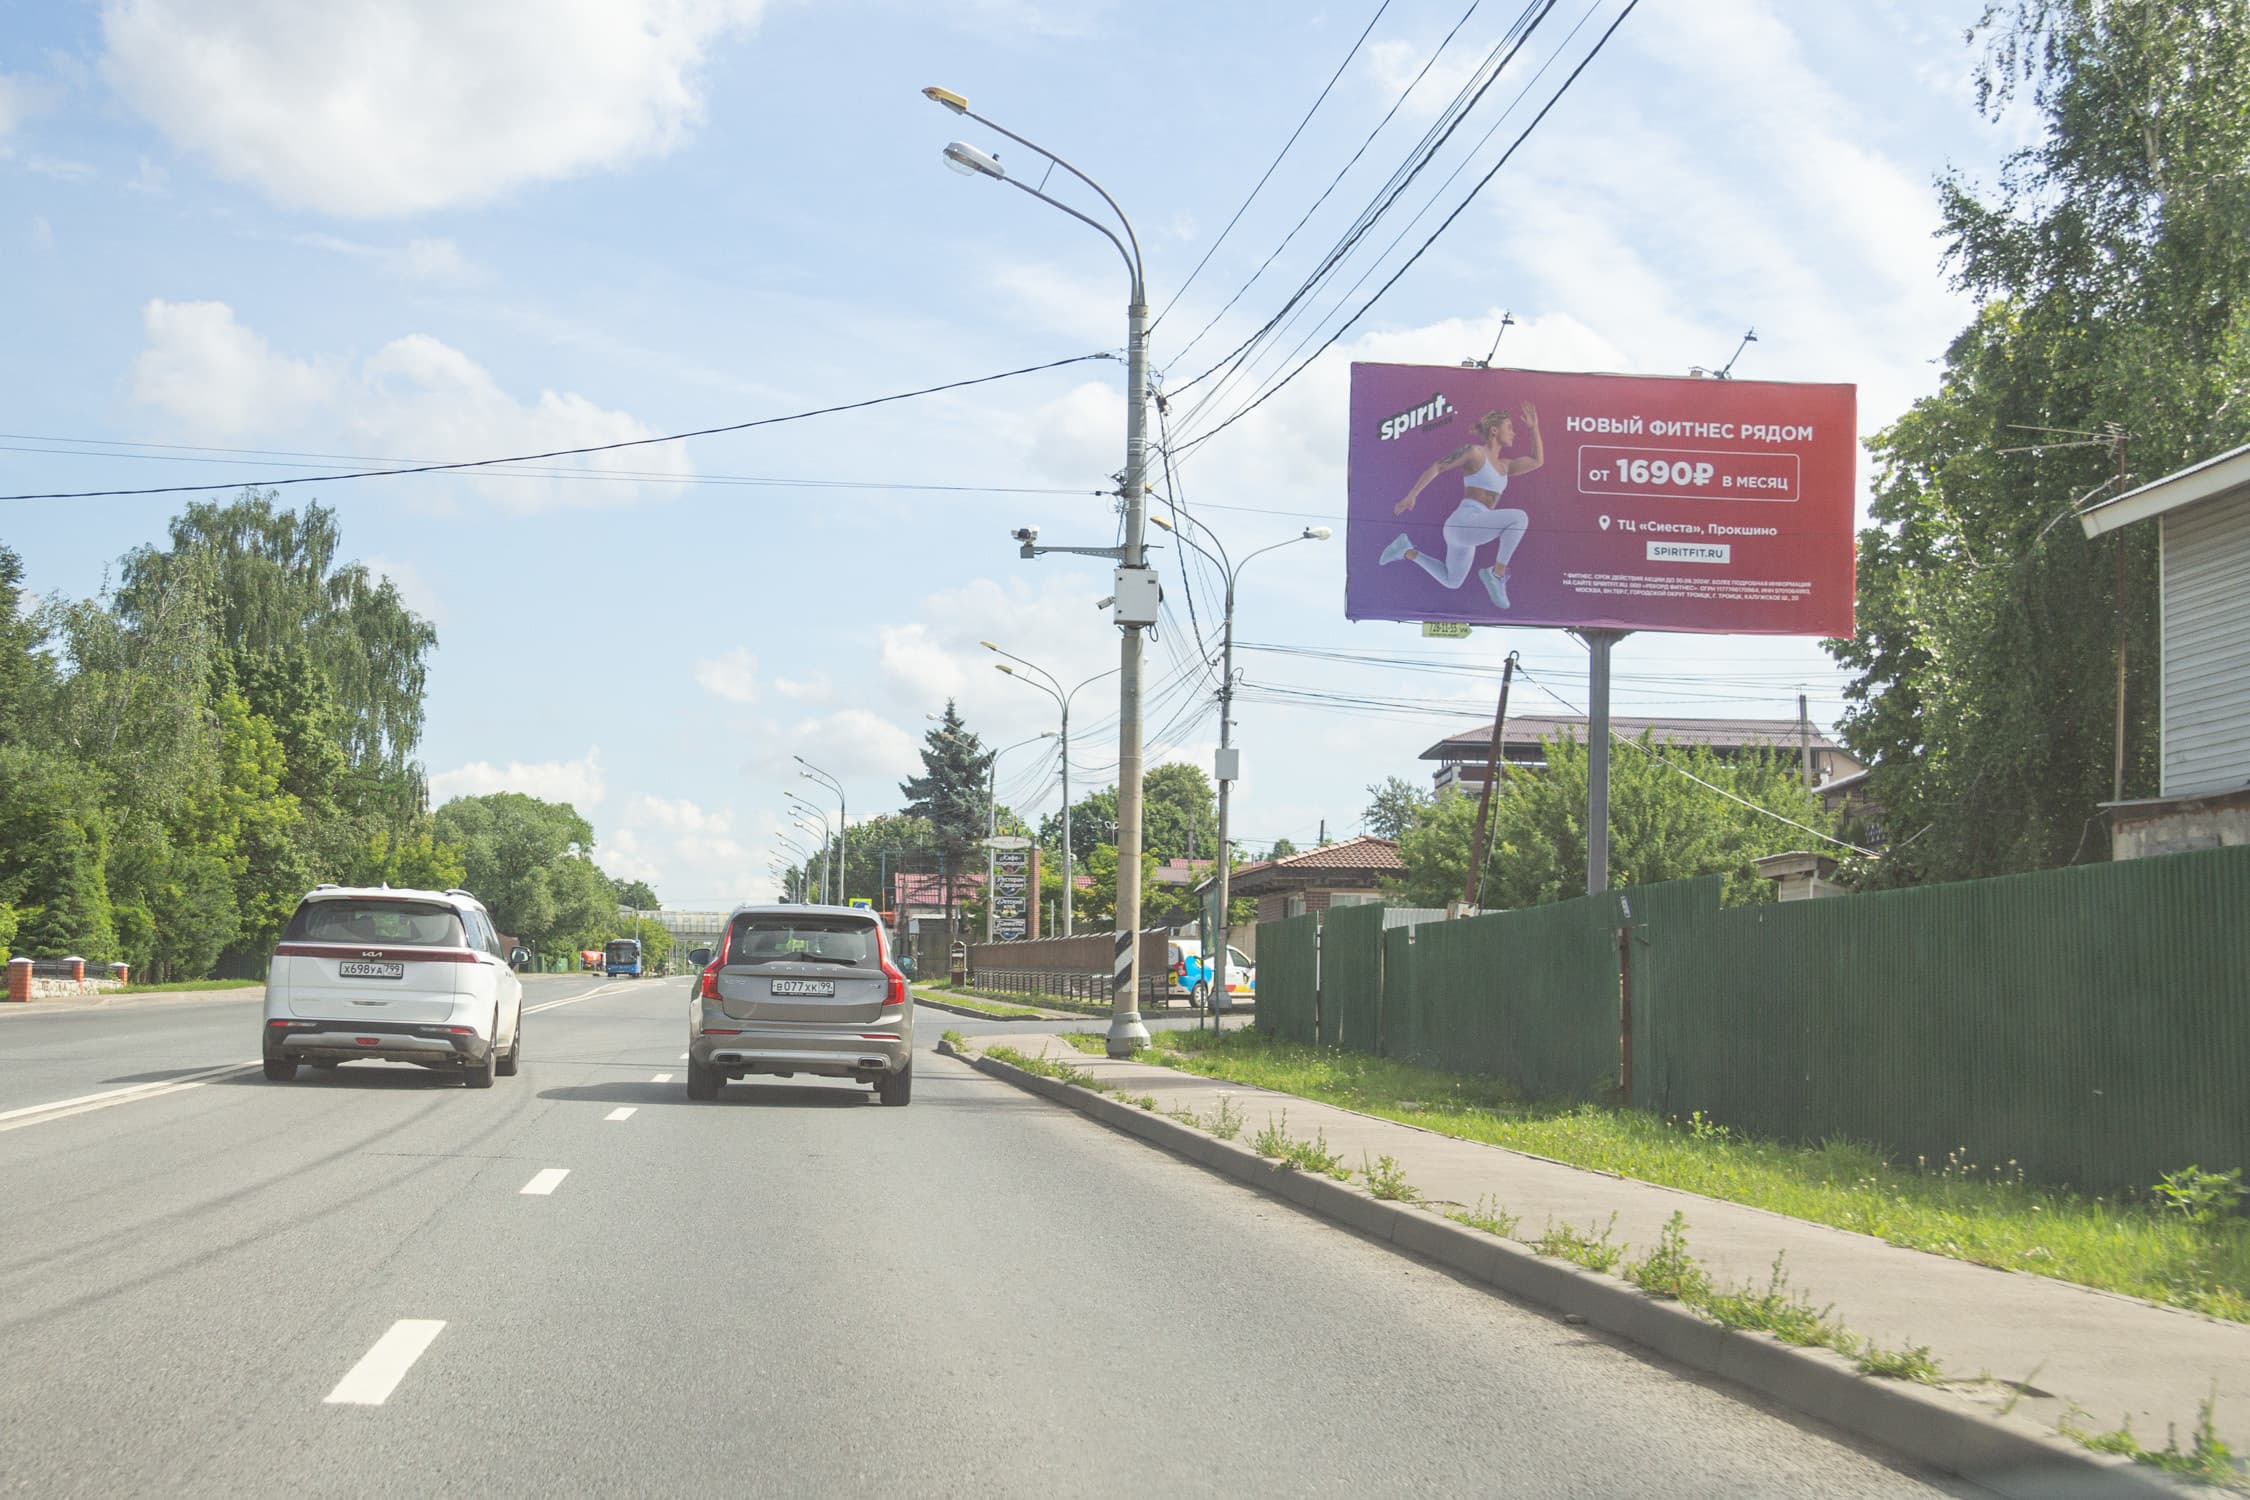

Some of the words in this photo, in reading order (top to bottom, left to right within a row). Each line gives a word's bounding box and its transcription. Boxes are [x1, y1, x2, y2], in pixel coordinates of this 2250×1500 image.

[1566, 415, 1643, 435] НОВЫЙ
[1649, 420, 1735, 440] ФИТНЕС
[1740, 424, 1814, 443] РЯДОМ
[1736, 476, 1788, 490] МЕСЯЦ
[1617, 519, 1636, 532] ТЦ
[1639, 520, 1705, 535] «Сиеста»,
[1708, 523, 1778, 537] Прокшино
[1653, 546, 1724, 559] SPIRITFIT.RU
